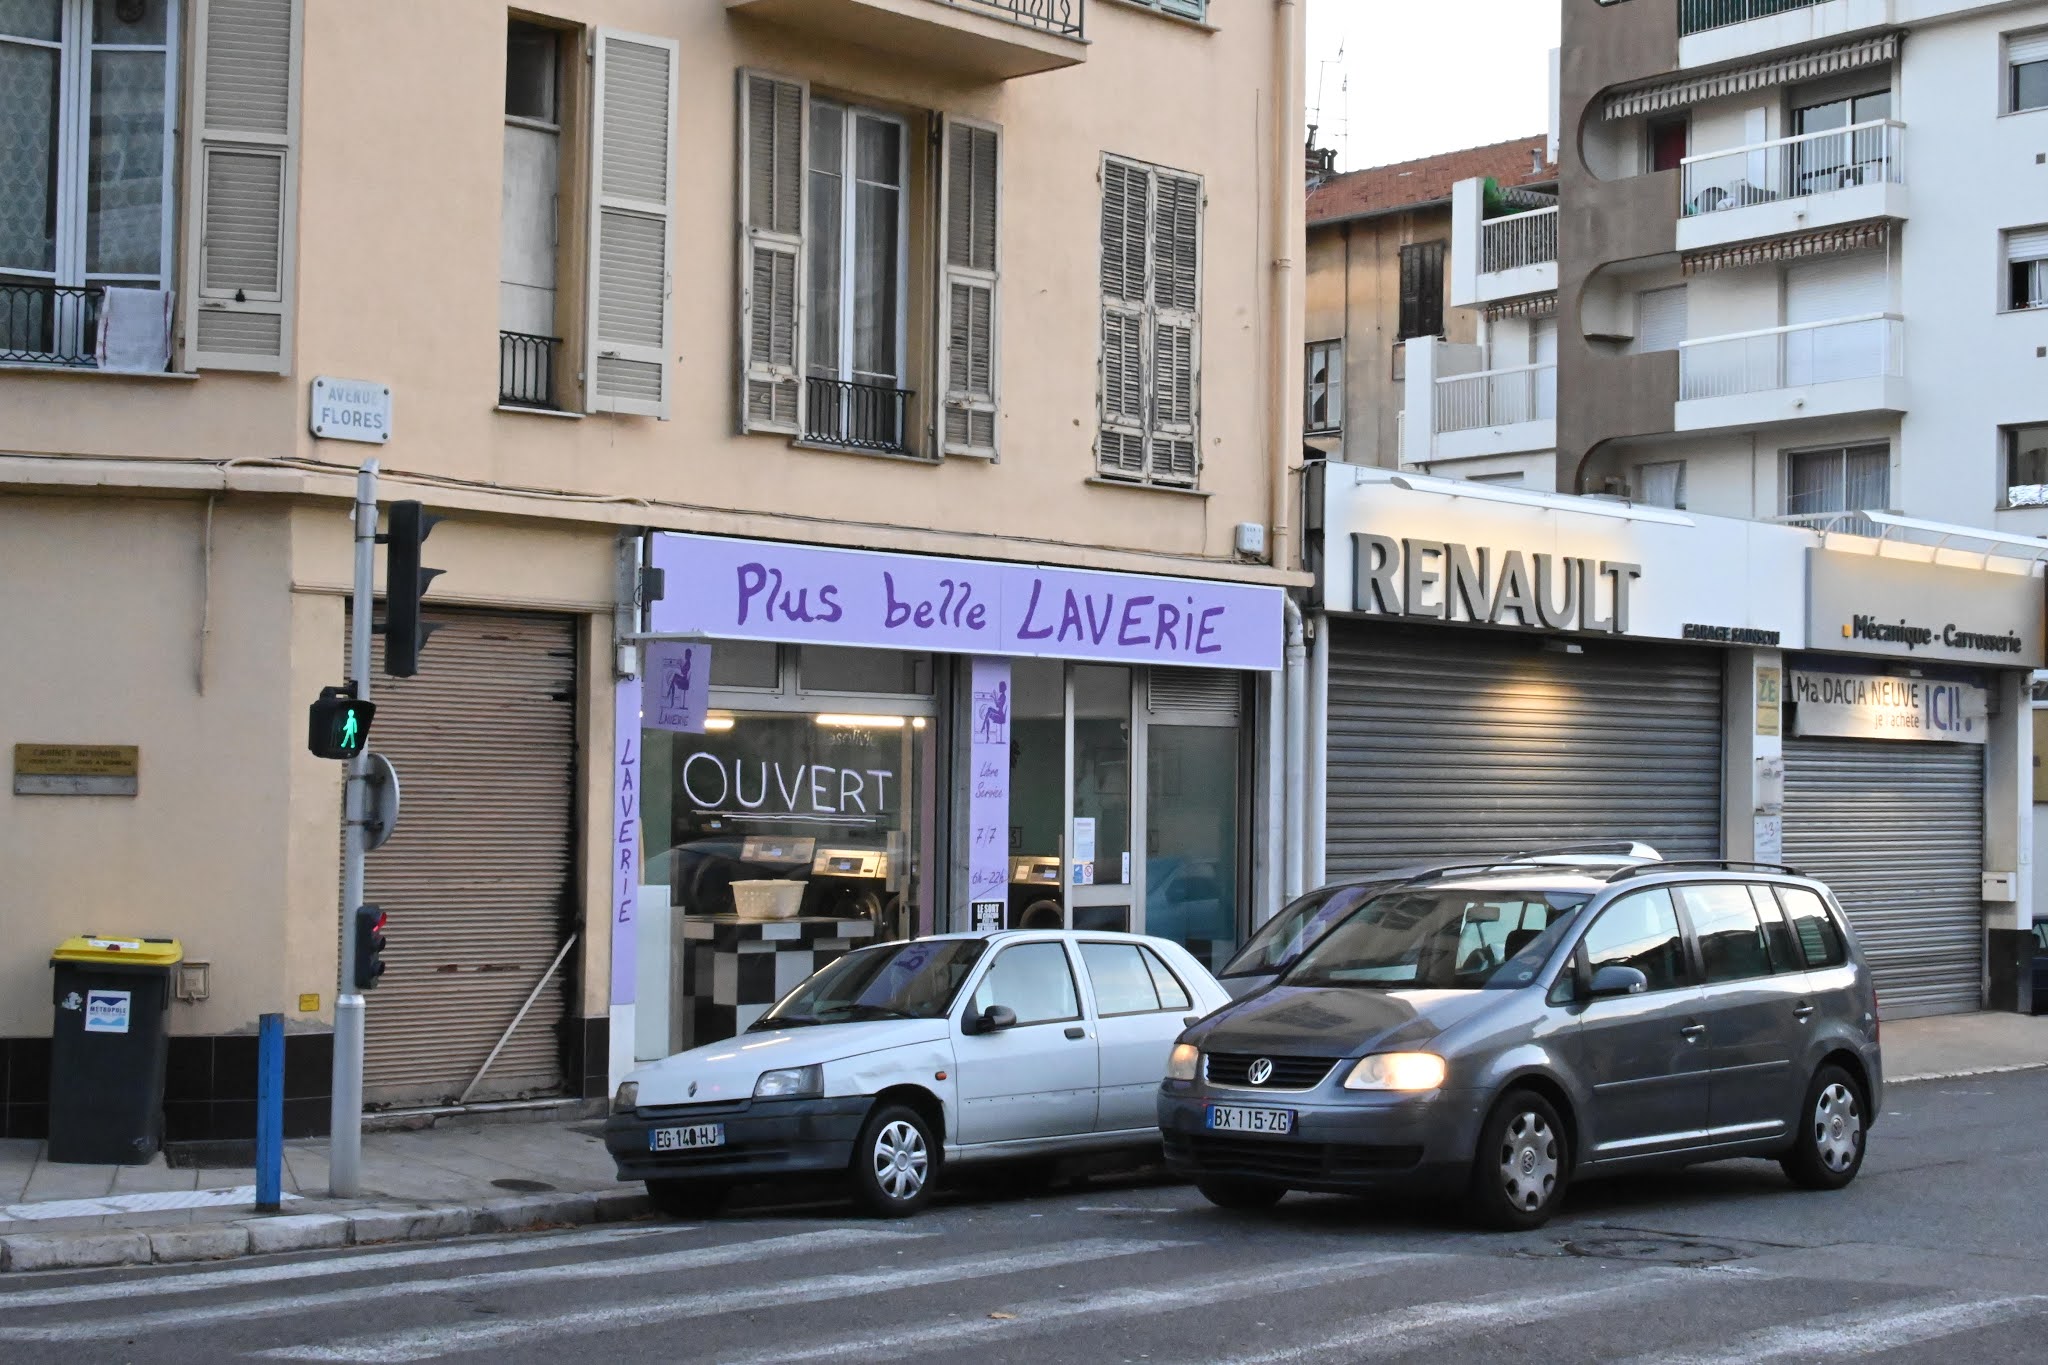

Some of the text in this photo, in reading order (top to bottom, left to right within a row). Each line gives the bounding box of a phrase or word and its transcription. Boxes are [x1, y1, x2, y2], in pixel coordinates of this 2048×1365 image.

[328, 387, 379, 406] AVENU
[322, 407, 383, 428] FLORES
[1350, 532, 1641, 634] RENAULT
[737, 562, 843, 626] Plus
[884, 571, 986, 630] belle
[1682, 623, 1731, 641] GARAGE
[1853, 614, 1932, 650] Mécanique
[1943, 623, 2022, 653] Carrosserie
[1797, 676, 1919, 708] Ma DACIA NEUVE
[1886, 712, 1920, 729] achète
[683, 751, 893, 814] OUVERT
[975, 781, 1003, 799] Service
[976, 827, 997, 848] 7/7
